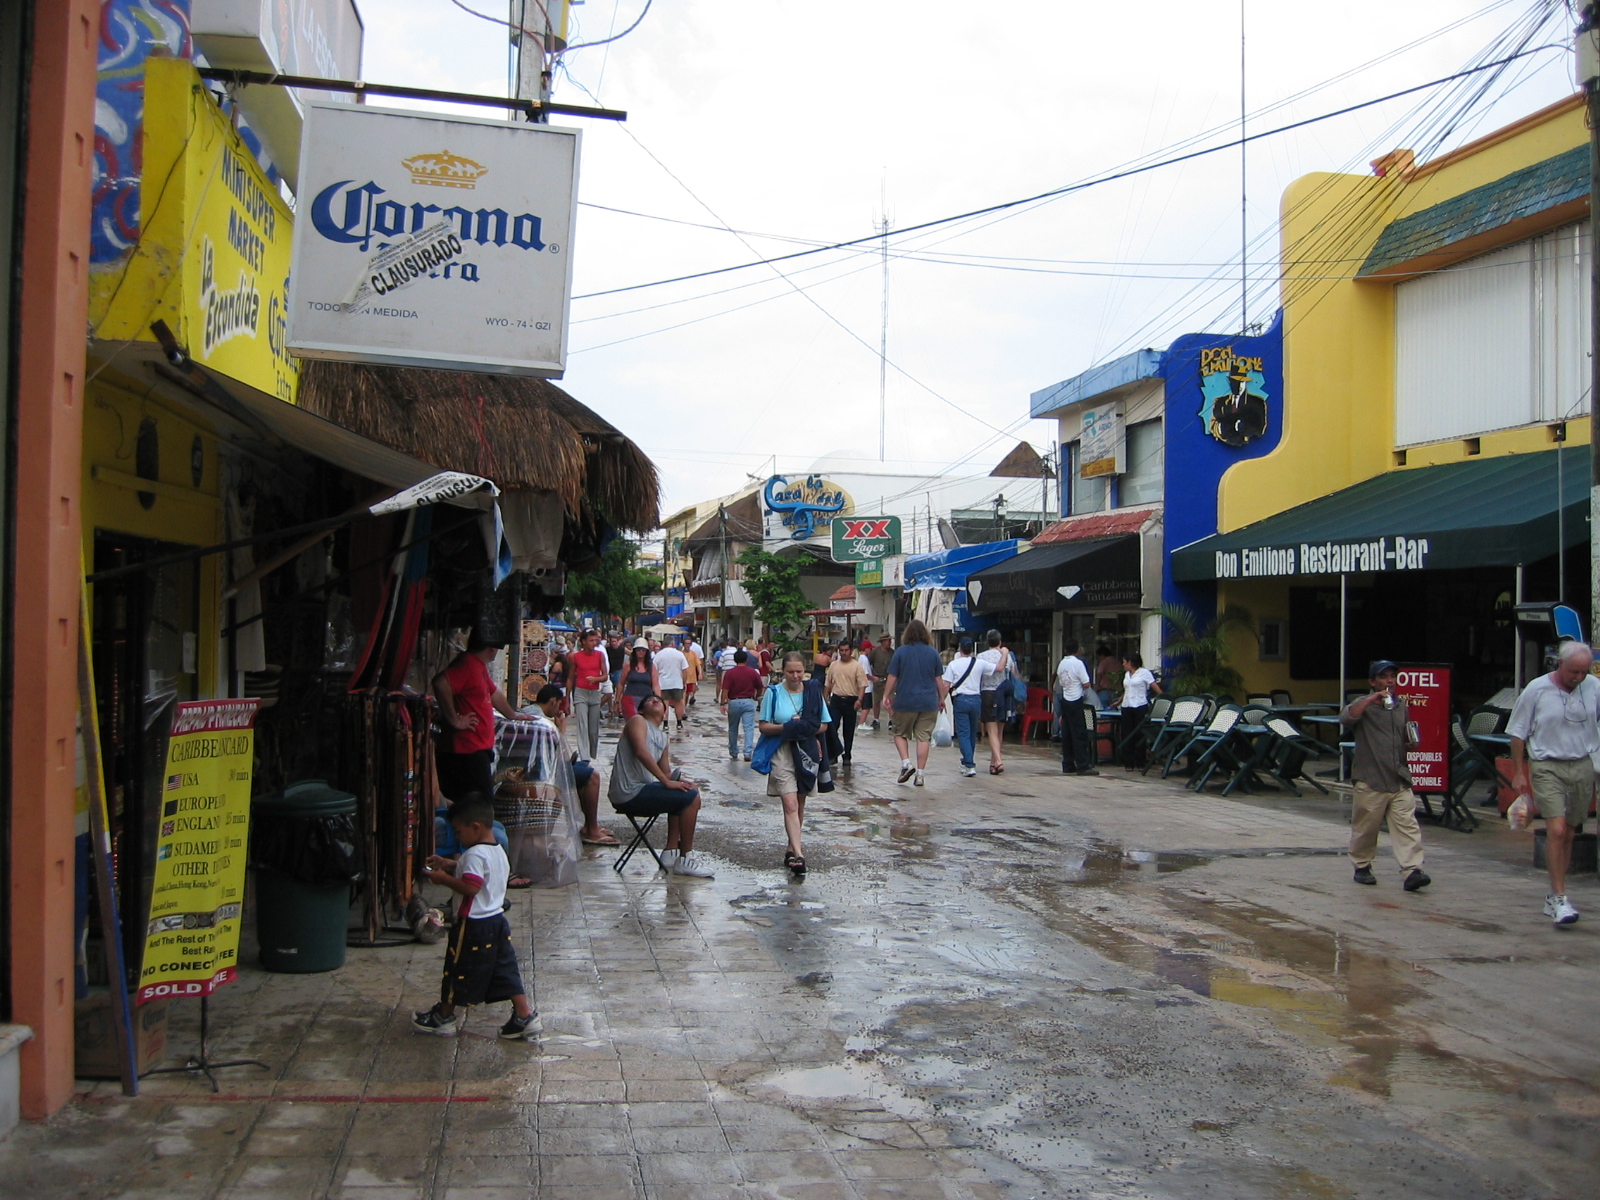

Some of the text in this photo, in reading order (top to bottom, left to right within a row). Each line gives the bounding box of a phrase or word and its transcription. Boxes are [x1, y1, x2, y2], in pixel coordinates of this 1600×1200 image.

[228, 205, 265, 275] MARKET
[371, 233, 463, 296] CLAUSURADO
[206, 277, 260, 350] Escondida
[308, 301, 341, 313] TODO
[373, 307, 419, 319] MEDIDA
[486, 317, 509, 328] WYO
[517, 319, 527, 329] 74
[842, 519, 892, 540] XX
[1216, 536, 1428, 578] Don Emilione Restaurant-Bar
[1082, 580, 1140, 591] Caribbean
[1396, 671, 1440, 688] OTEL
[1409, 763, 1431, 774] ANCY
[181, 773, 199, 787] USA
[1411, 776, 1443, 787] SPONIBILE
[172, 861, 209, 877] OTHER
[162, 936, 175, 945] The
[176, 933, 196, 944] Rest
[197, 932, 207, 943] of
[182, 946, 202, 956] Best
[219, 949, 235, 960] FEE
[144, 982, 203, 999] SOLD
